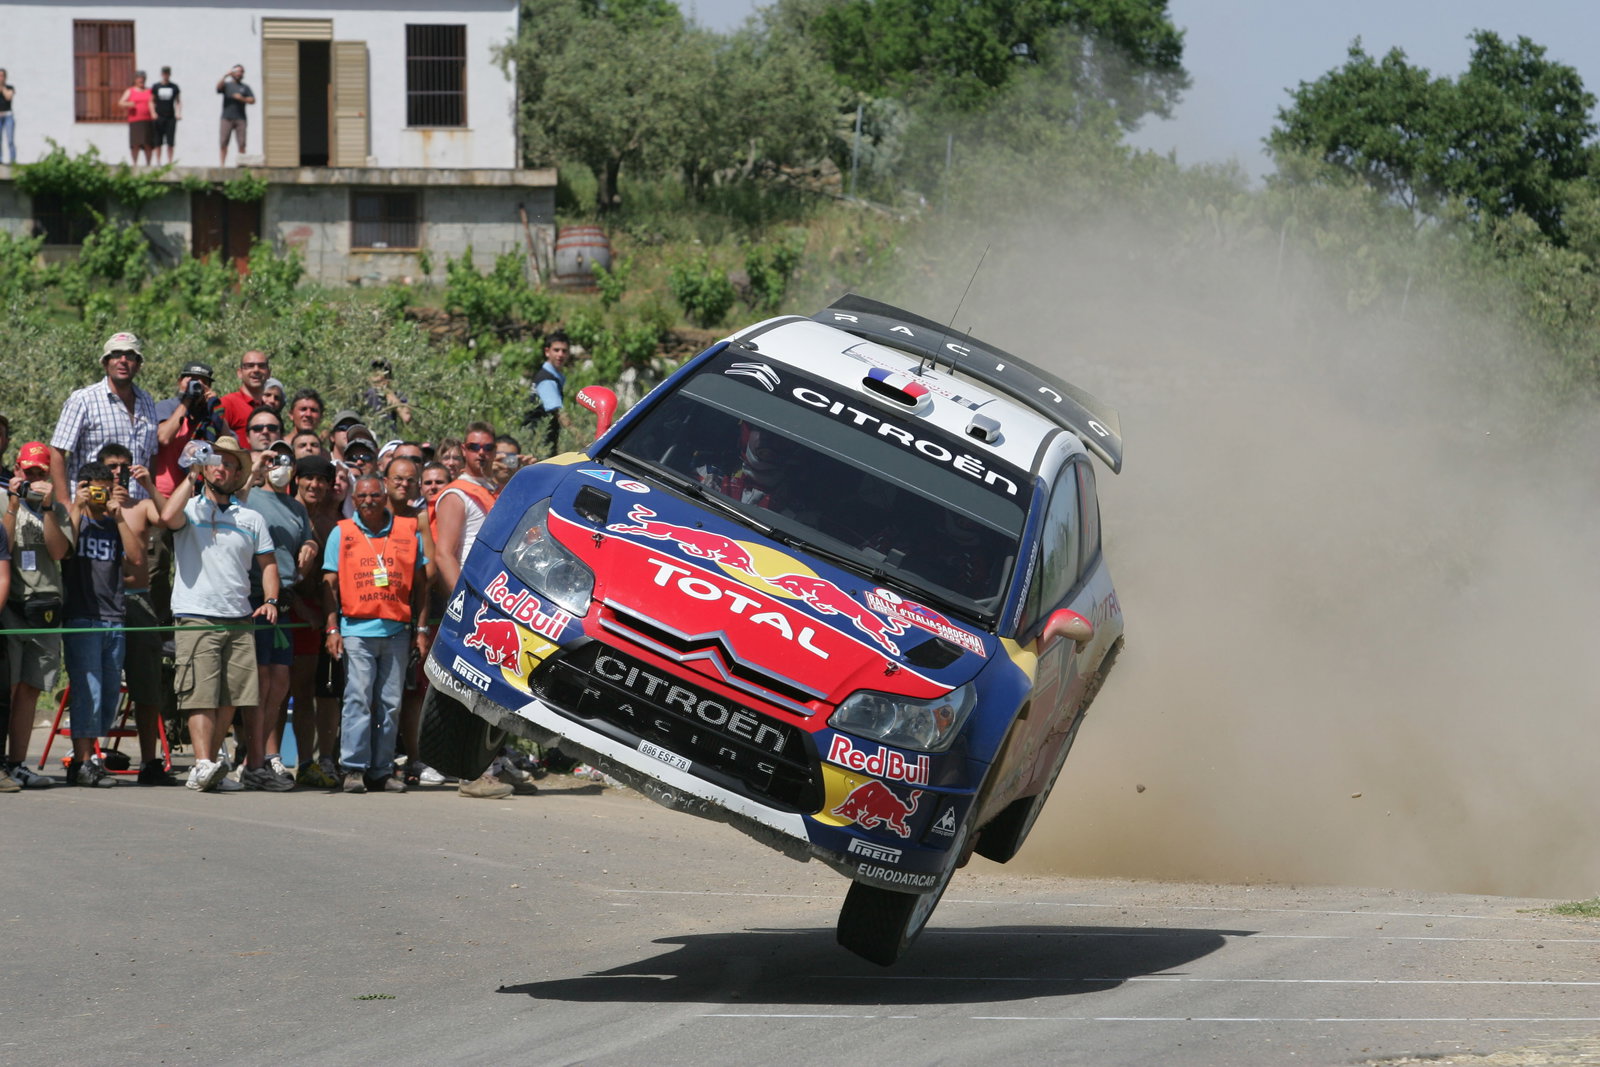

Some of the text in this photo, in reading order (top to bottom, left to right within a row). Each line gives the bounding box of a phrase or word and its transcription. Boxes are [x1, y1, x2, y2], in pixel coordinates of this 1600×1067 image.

[647, 557, 830, 660] TOTAL
[868, 594, 897, 614] RALLY
[452, 655, 492, 692] PIRELLI
[641, 744, 687, 770] 886 ESF 78
[848, 837, 902, 864] PIRELLI
[857, 863, 937, 888] EURODATACAR
